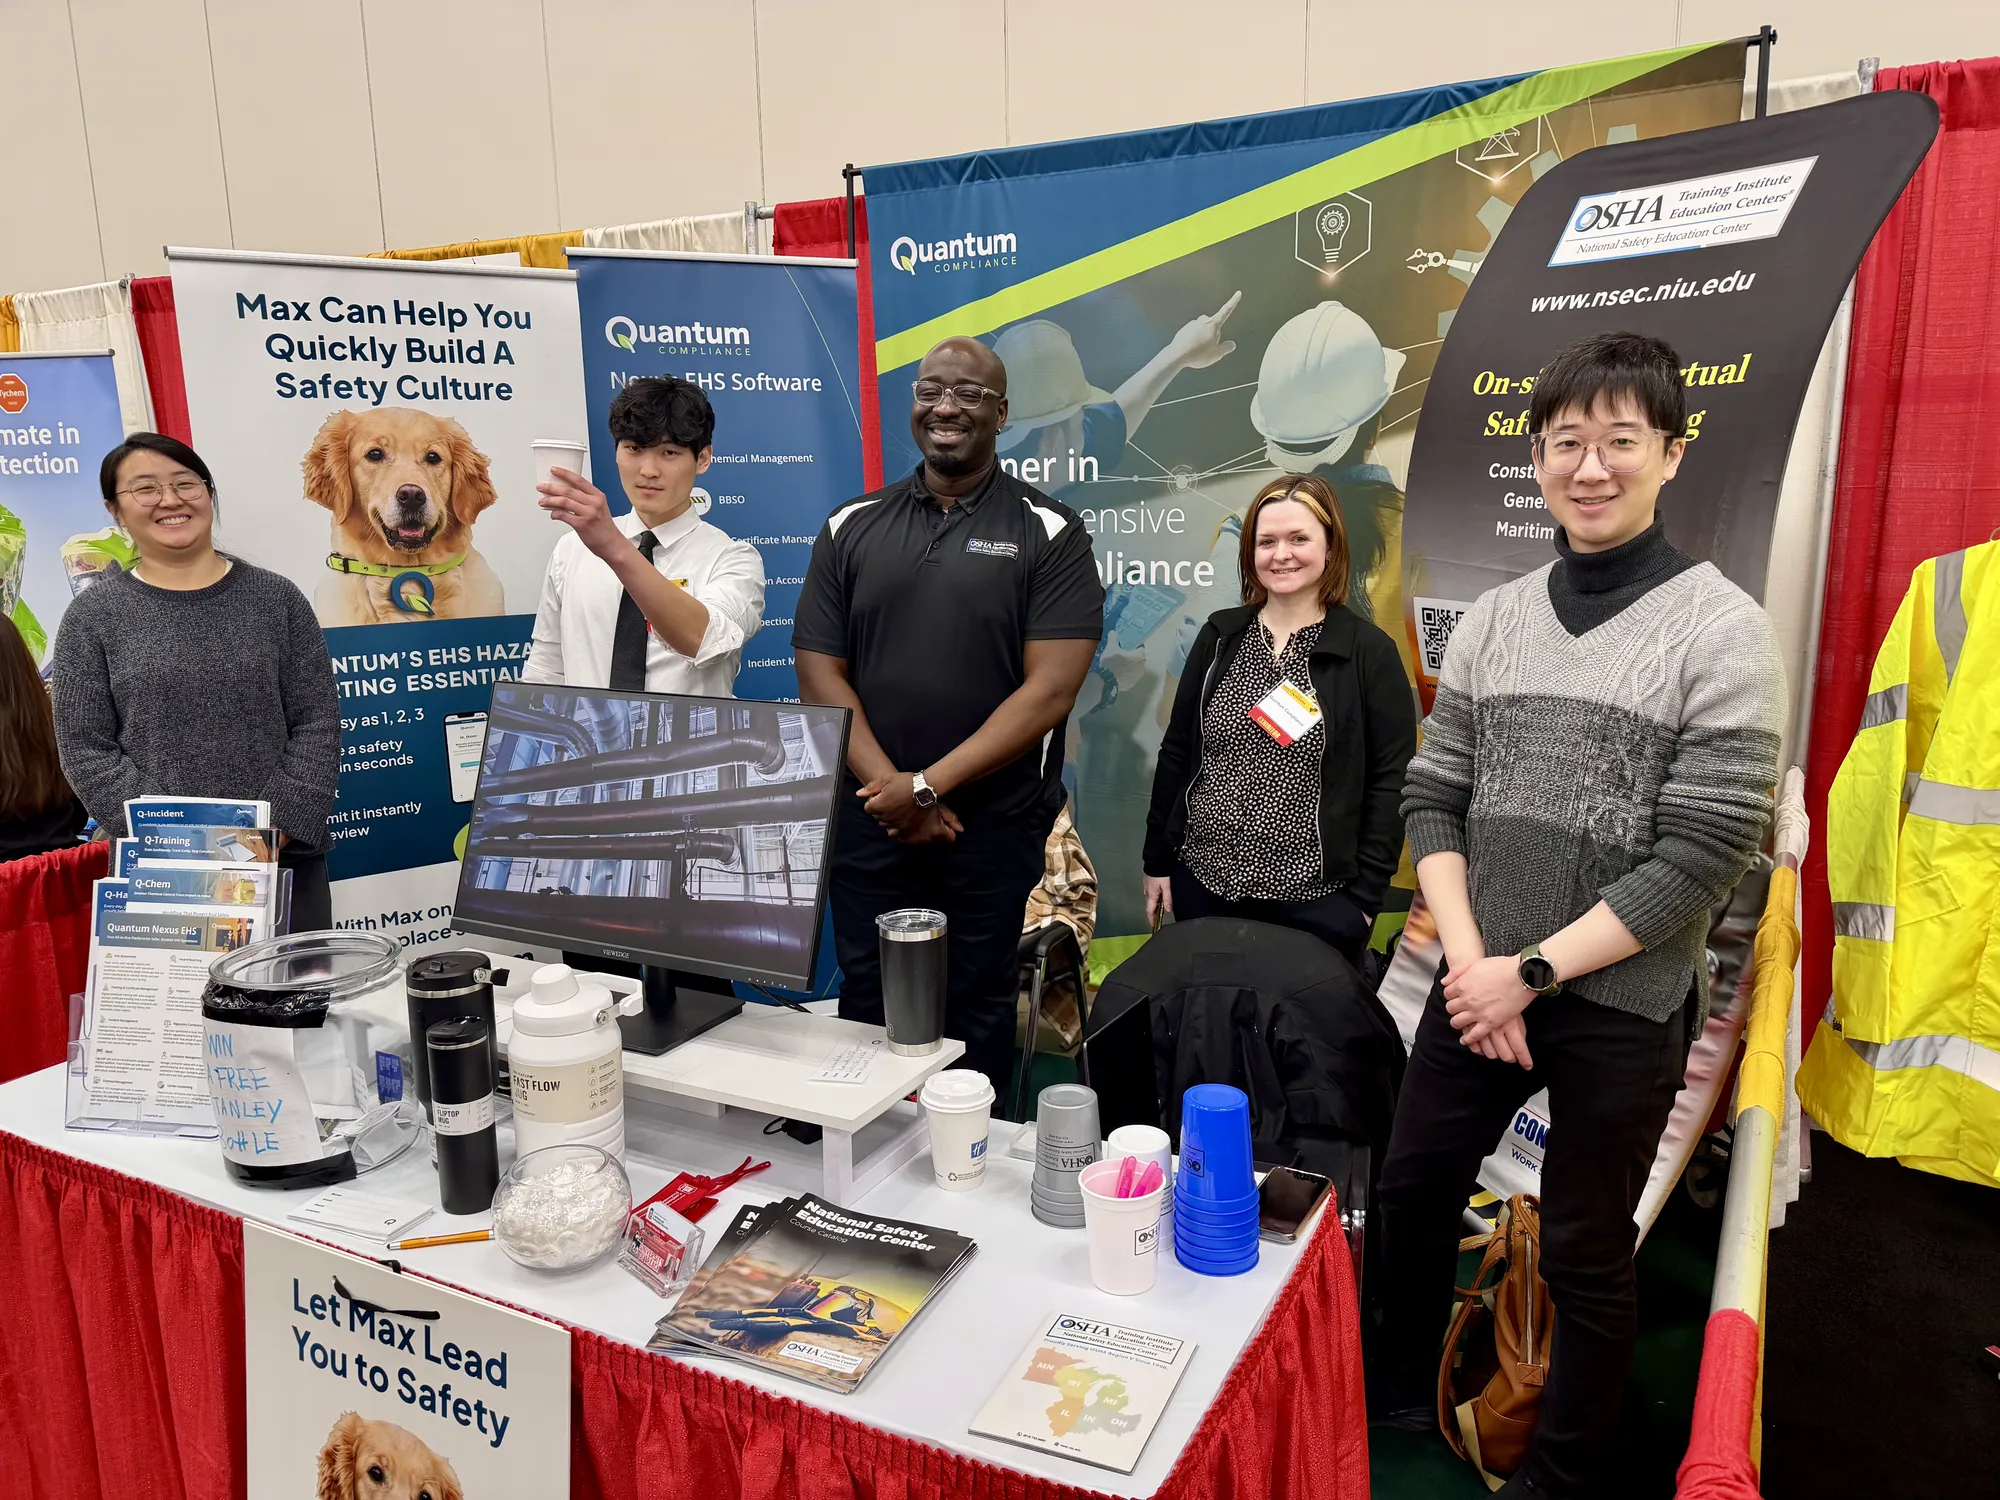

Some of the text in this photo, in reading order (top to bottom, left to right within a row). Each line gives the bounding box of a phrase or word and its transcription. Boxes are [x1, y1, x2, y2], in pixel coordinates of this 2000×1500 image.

[1678, 173, 1792, 203] Training Institute
[1574, 194, 1666, 233] OSHA
[1668, 200, 1732, 220] Education
[1576, 221, 1752, 255] National Safety Education Center
[891, 232, 1017, 275] Quantum
[934, 256, 1017, 273] COMPLIANCE
[1530, 269, 1757, 313] www.nsec.niu.edu
[236, 292, 532, 333] Max Can Help You
[605, 316, 751, 353] Quantum
[265, 334, 515, 369] Quickly Build A
[658, 346, 751, 356] COMPLIANCE
[275, 372, 513, 406] Safety Culture
[731, 373, 822, 392] Software
[58, 421, 80, 444] in
[0, 451, 79, 475] tection
[710, 454, 814, 465] hemical Management
[1068, 448, 1099, 482] in
[719, 495, 745, 504] BBSO
[1079, 500, 1186, 534] ensive
[1496, 521, 1554, 540] Maritim
[776, 577, 806, 585] Accou
[429, 646, 471, 666] EHS
[748, 658, 786, 668] Incident
[407, 666, 522, 692] ESSENTIAL
[361, 715, 379, 727] as
[381, 712, 394, 725] 1,
[396, 709, 411, 723] 2,
[415, 708, 425, 721] 3
[348, 740, 403, 756] a safety
[354, 753, 414, 771] seconds
[137, 809, 184, 819] Q-Incident
[351, 809, 361, 821] it
[363, 801, 422, 819] instantly
[145, 835, 191, 847] Q-Training
[135, 879, 171, 889] Q-Chem
[381, 909, 423, 929] Max
[427, 904, 452, 919] on
[107, 923, 197, 936] Quantum Nexus EHS
[397, 927, 452, 948] place
[214, 1067, 270, 1090] FREE
[513, 1075, 561, 1092] FAST FLOW
[1061, 1155, 1093, 1168] OSHA
[1511, 1148, 1538, 1172] WORK
[804, 1200, 929, 1241] National Safety
[789, 1218, 848, 1243] Course Catalog
[795, 1209, 936, 1252] Education Center
[293, 1277, 507, 1389] Let Max Lead
[1060, 1319, 1111, 1337] OSHA
[1117, 1329, 1174, 1346] Training Institute
[787, 1342, 819, 1356] OSHA
[1063, 1331, 1158, 1357] National Safety Education Center
[1114, 1334, 1146, 1346] Education
[1037, 1361, 1055, 1372] MN
[292, 1325, 510, 1449] You to Safety
[1067, 1378, 1081, 1388] WI
[1103, 1396, 1117, 1406] MI
[1060, 1409, 1071, 1418] IL
[1083, 1413, 1096, 1424] IN
[1110, 1417, 1128, 1428] OH
